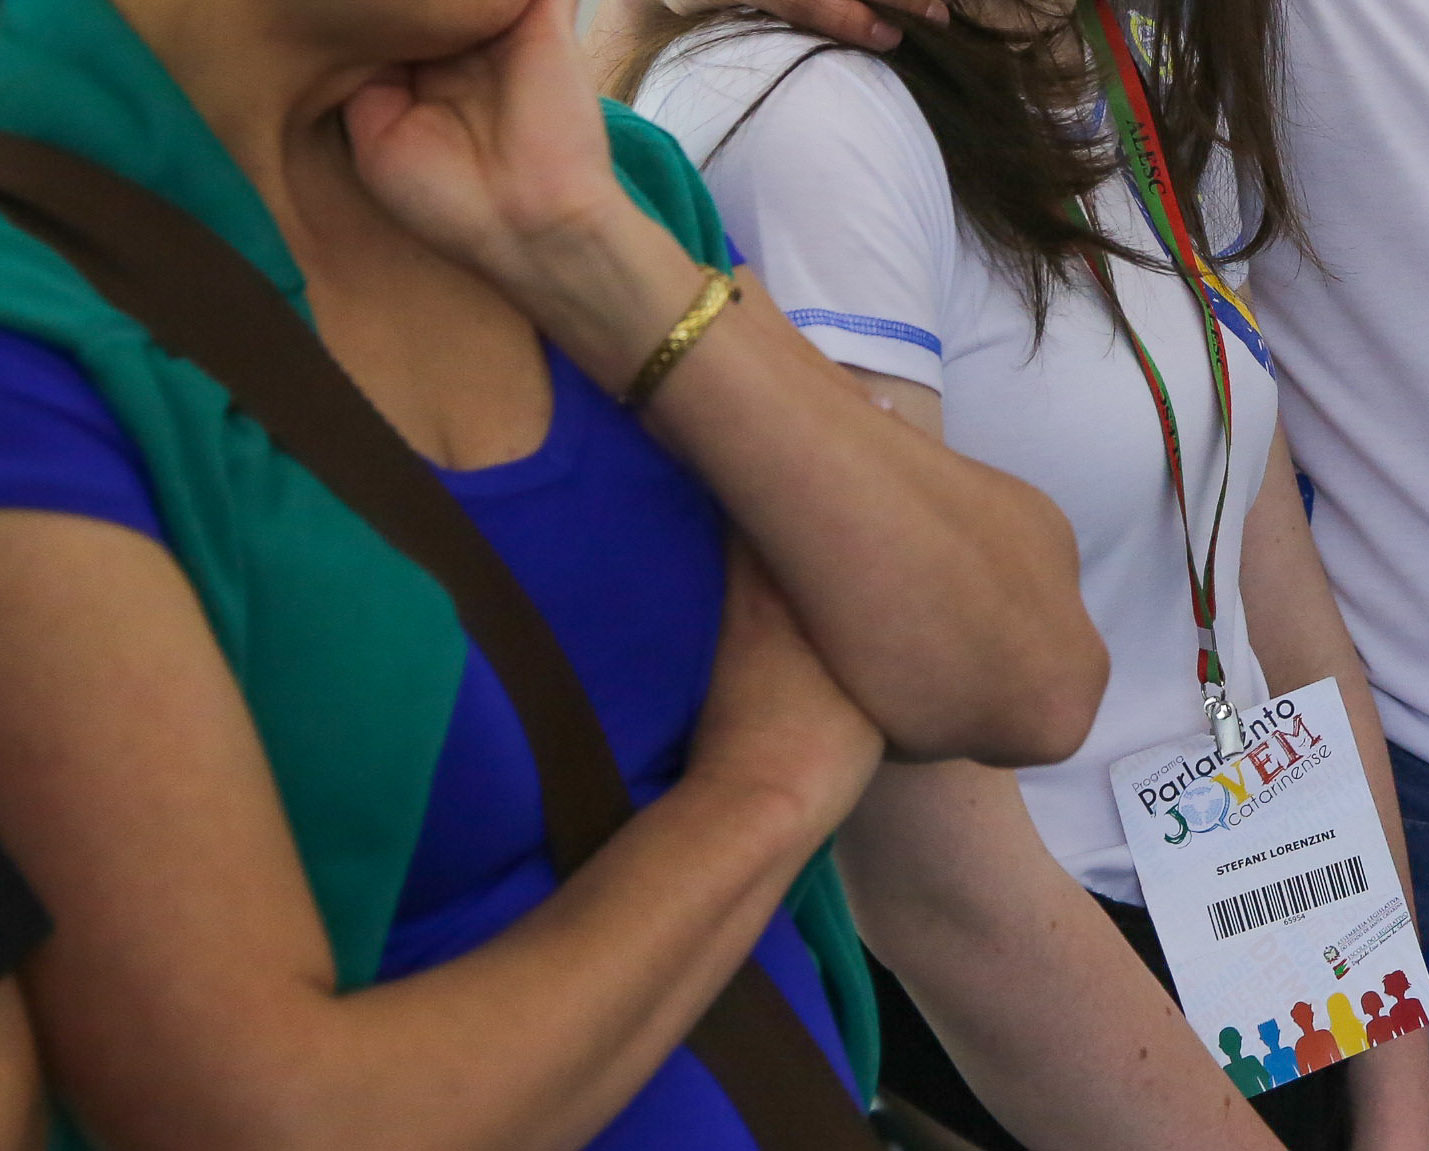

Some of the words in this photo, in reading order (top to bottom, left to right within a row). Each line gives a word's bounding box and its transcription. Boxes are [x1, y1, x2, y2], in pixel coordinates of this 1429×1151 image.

[1126, 120, 1167, 196] ALESC
[1132, 755, 1184, 792] Programa
[1138, 699, 1295, 814] Parlanto
[1164, 713, 1323, 845] JOVEM
[1228, 745, 1331, 826] catarinense
[1216, 851, 1268, 876] STEFANI
[1269, 829, 1336, 860] LORENZINI
[1283, 914, 1306, 926] 65954
